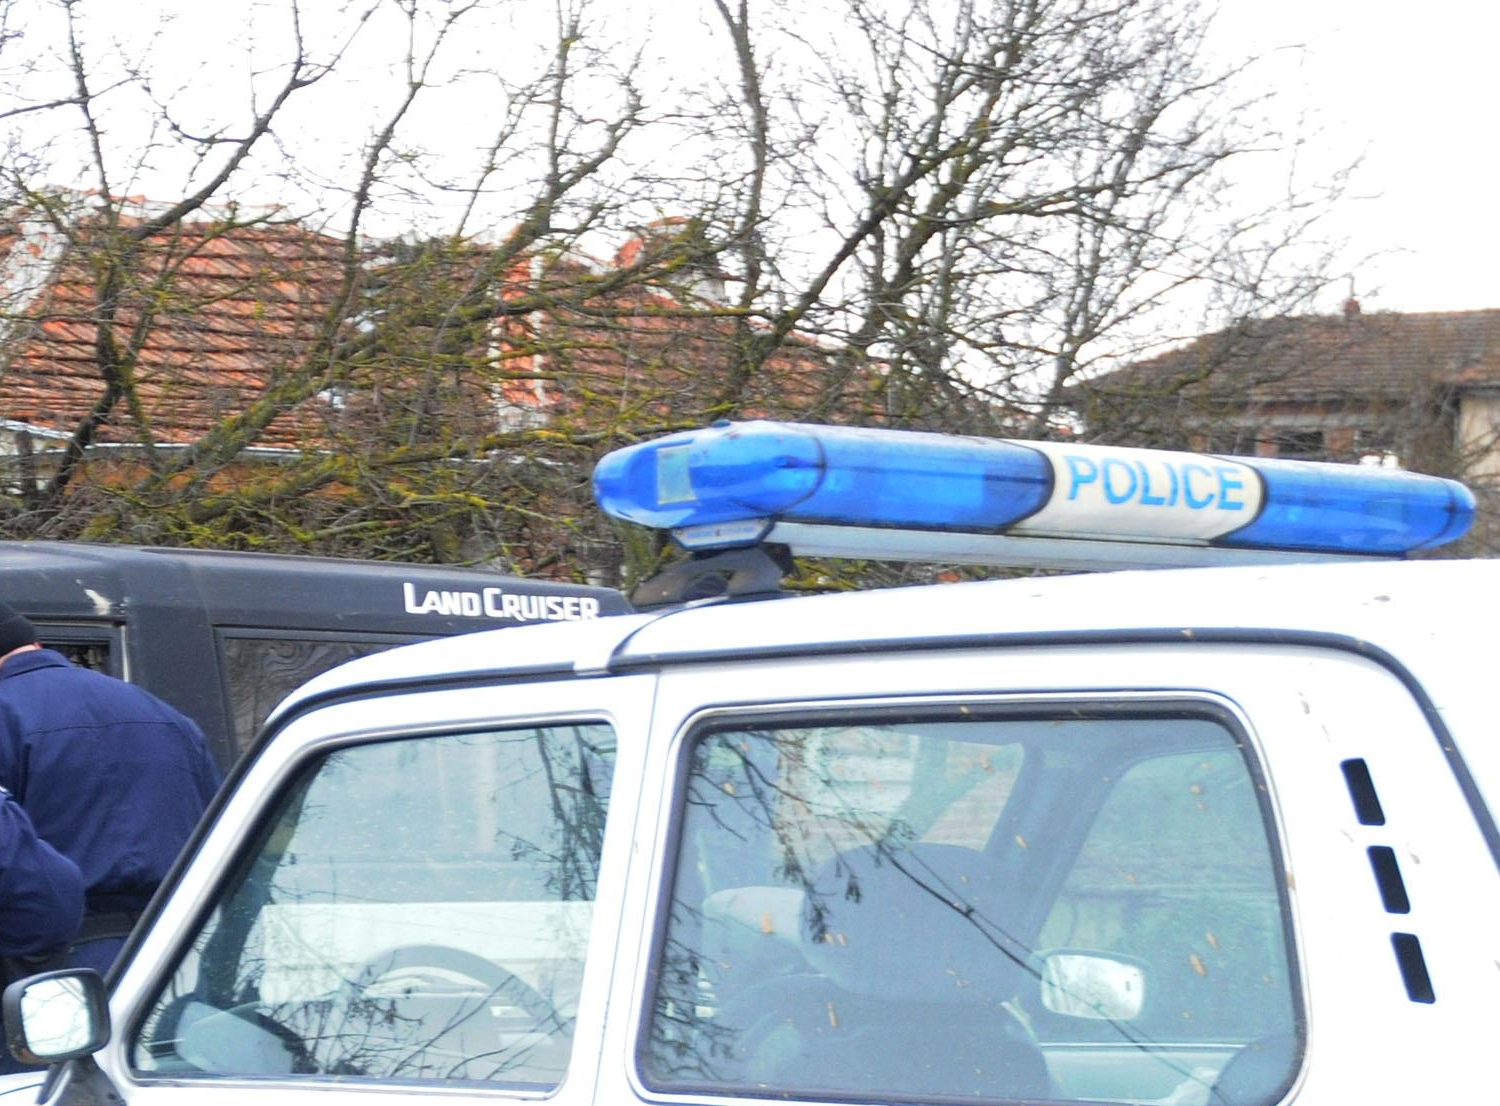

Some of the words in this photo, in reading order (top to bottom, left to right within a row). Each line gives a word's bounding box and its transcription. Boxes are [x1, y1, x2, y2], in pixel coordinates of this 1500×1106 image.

[1063, 455, 1245, 511] POLICE
[403, 582, 483, 617] LAND
[483, 587, 600, 622] CRUISER
